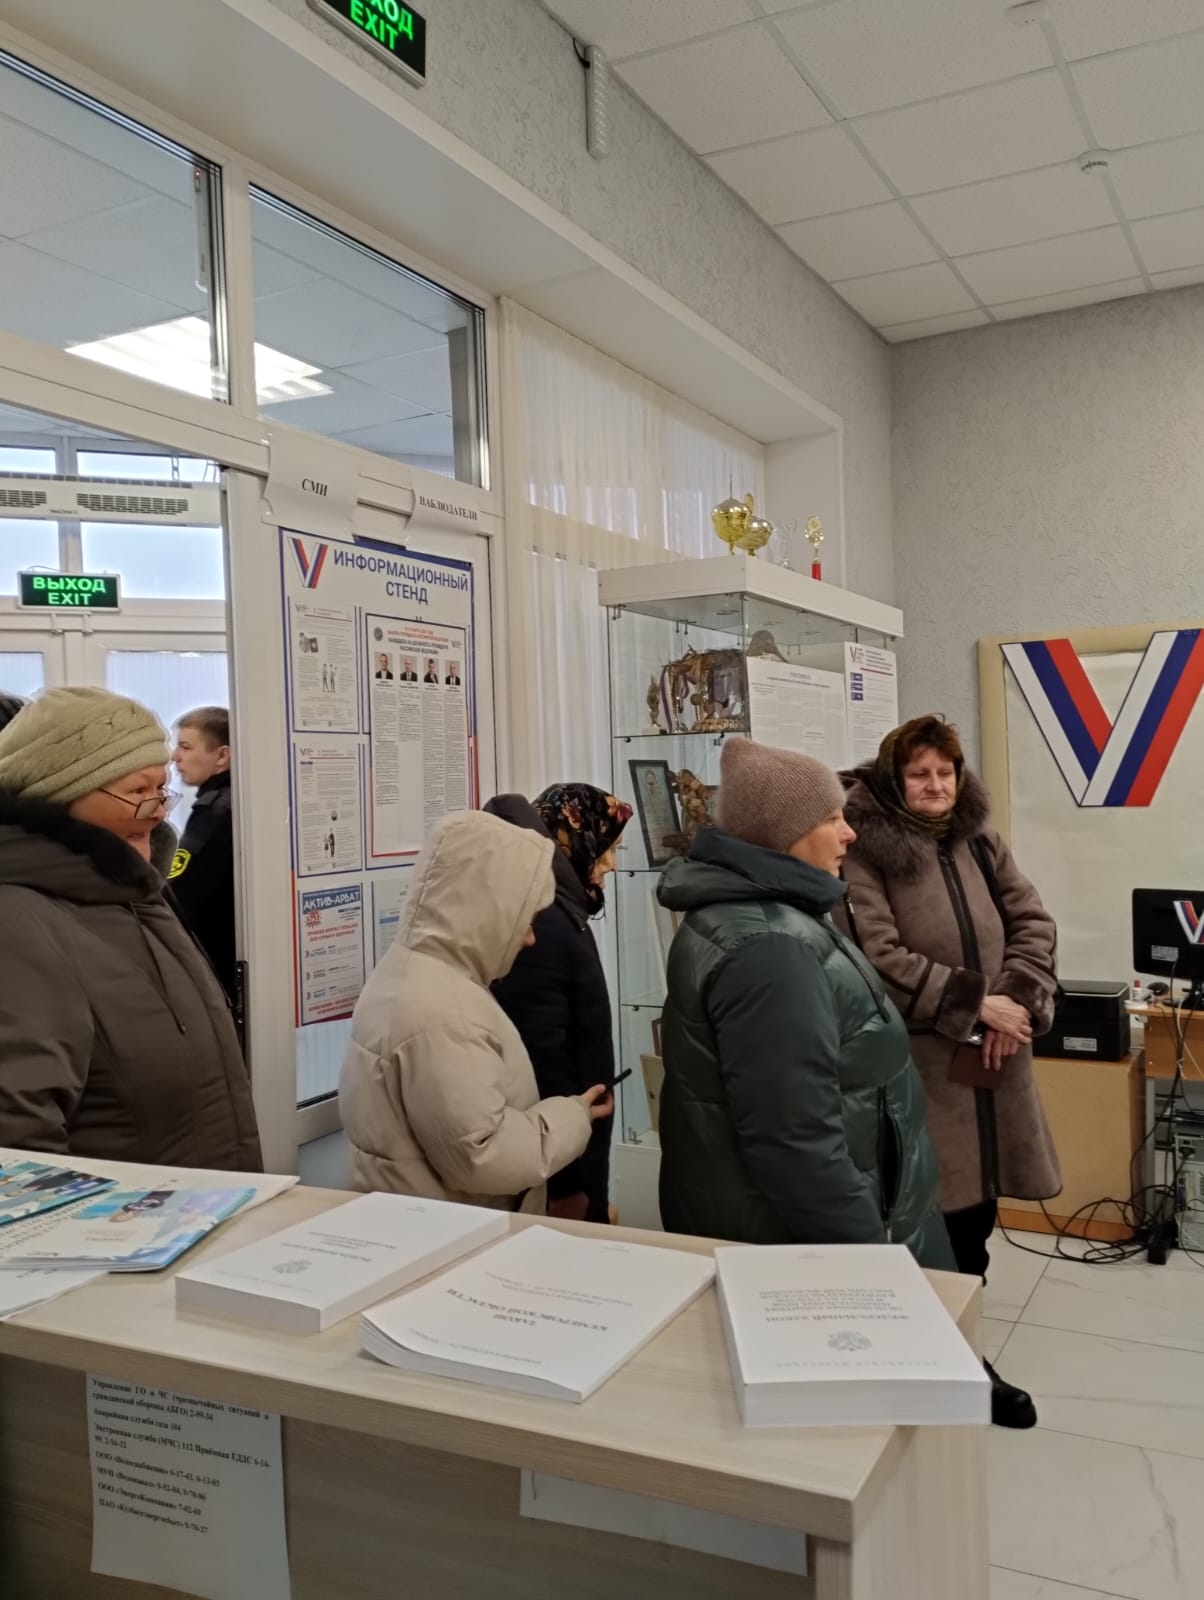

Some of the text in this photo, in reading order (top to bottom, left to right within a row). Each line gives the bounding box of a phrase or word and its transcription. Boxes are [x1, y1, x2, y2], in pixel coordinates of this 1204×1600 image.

[350, 0, 399, 50] EXIT
[301, 478, 328, 497] СМИ
[418, 495, 478, 521] НАБЛЮДАТЕЛИ
[333, 549, 469, 591] ИНФОРМАЦИОННЫЙ
[32, 577, 106, 593] ВЫХОД
[385, 581, 428, 605] СТЕНД
[47, 593, 92, 606] EXIT
[135, 1386, 146, 1395] ГО
[158, 1390, 169, 1400] ЧС
[130, 1416, 154, 1426] служба
[133, 1433, 157, 1443] служба
[158, 1437, 181, 1449] (МЧС)
[182, 1442, 194, 1451] 112
[96, 1451, 112, 1460] ООО
[97, 1466, 114, 1477] МУП
[98, 1482, 115, 1492] ООО
